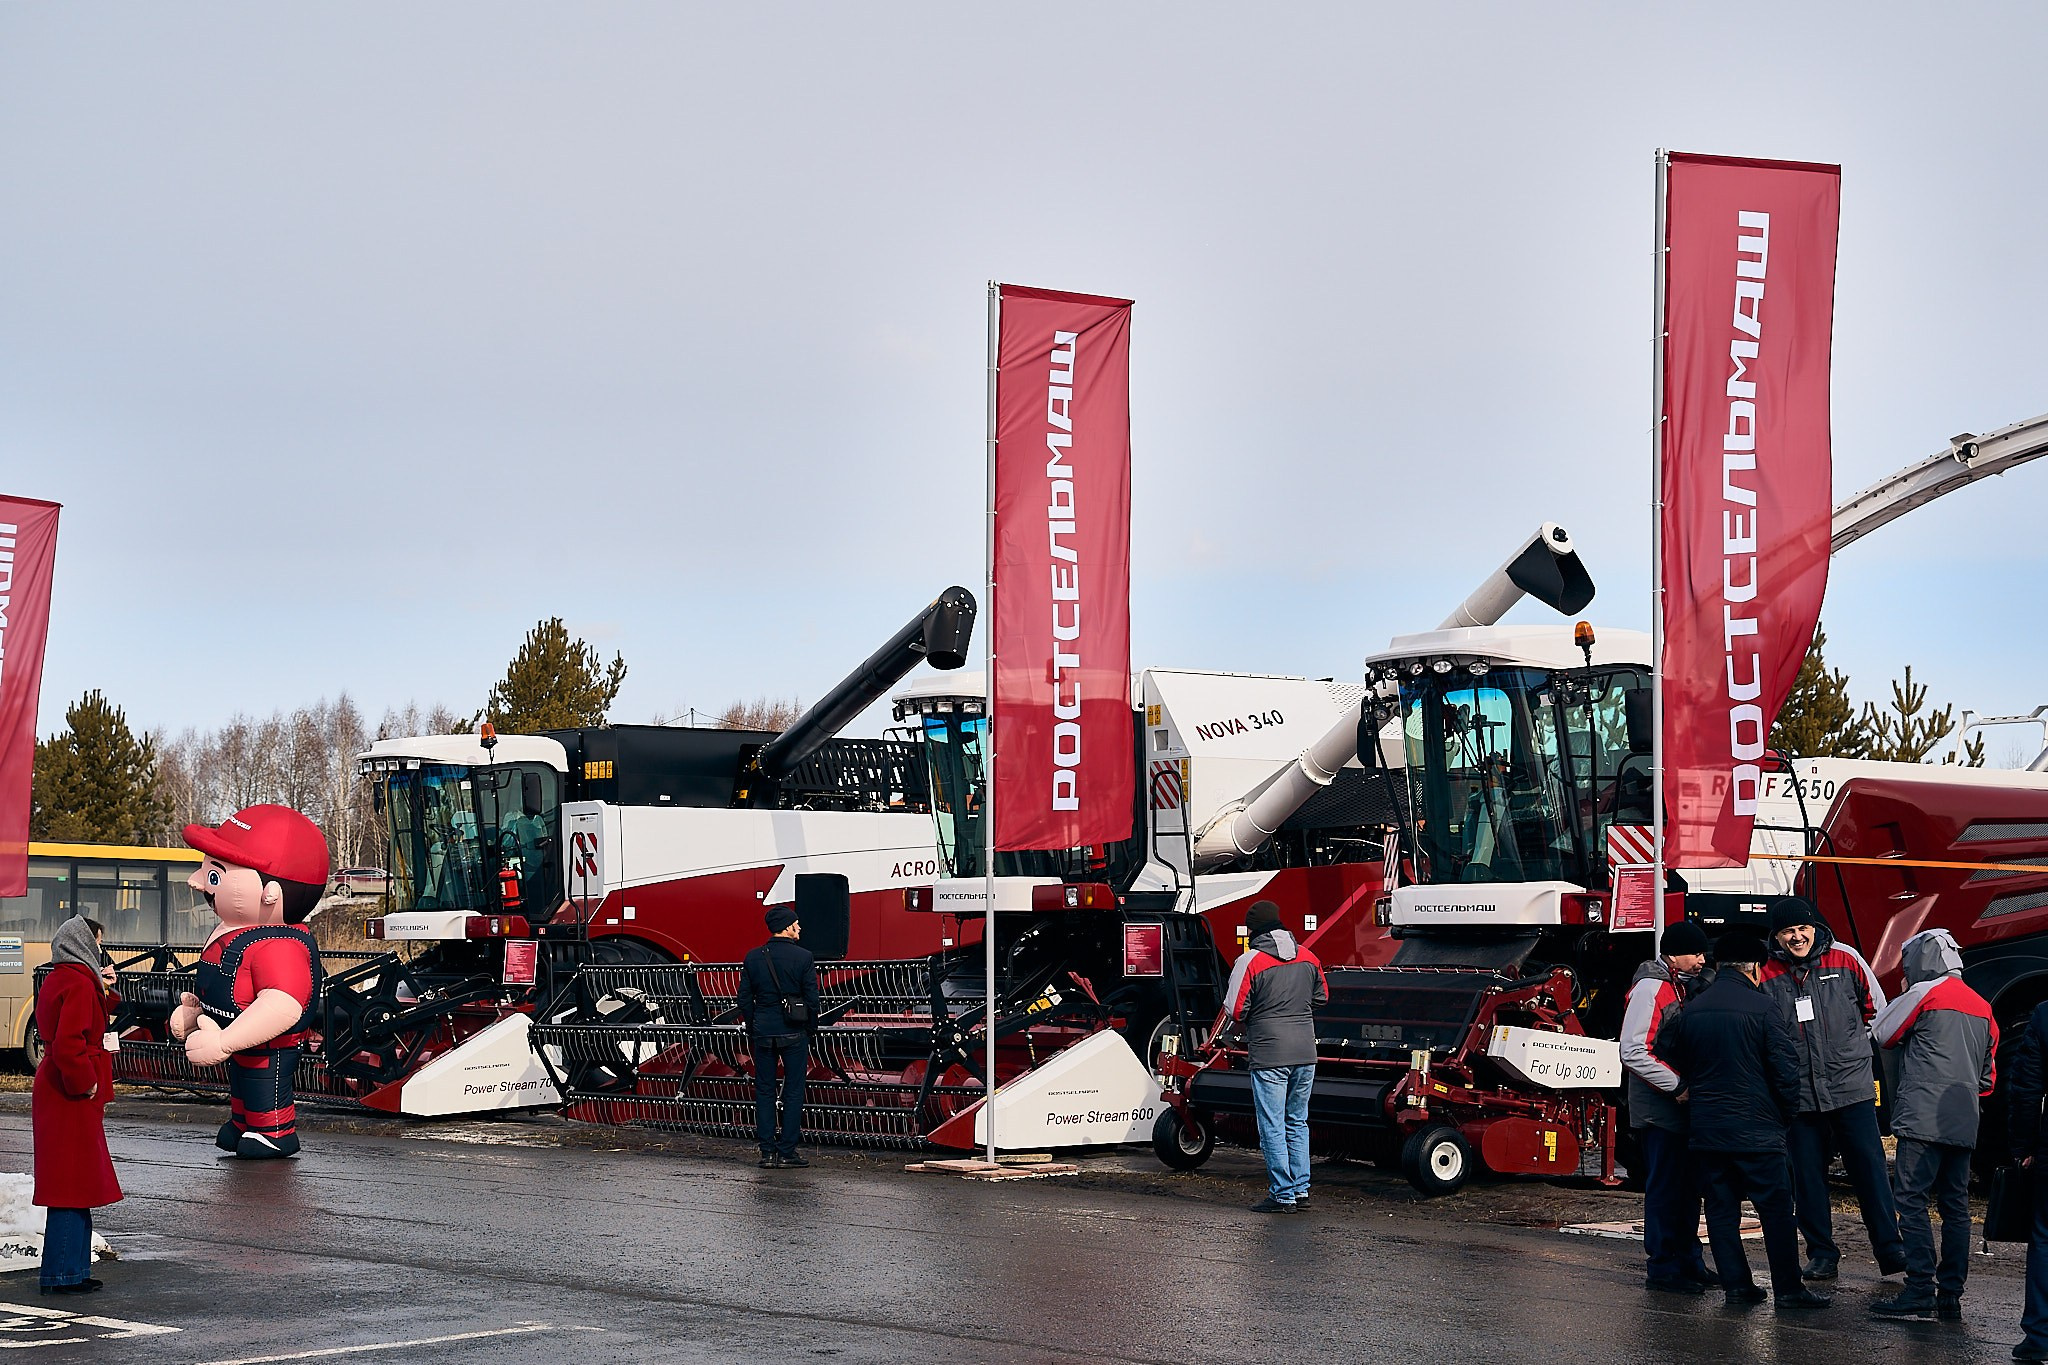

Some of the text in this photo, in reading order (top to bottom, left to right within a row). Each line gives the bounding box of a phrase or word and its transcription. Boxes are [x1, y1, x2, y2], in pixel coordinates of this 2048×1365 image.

[1722, 209, 1770, 816] РОСТСЕЛЬМАШ
[1046, 330, 1081, 811] РОСТСЕЛЬМАШ
[1195, 709, 1284, 741] NOVA 340
[1765, 777, 1835, 800] F 2650
[1414, 904, 1496, 912] РОСТСЕЛЬМАШ
[1530, 1059, 1597, 1080] For Up 300
[463, 1078, 552, 1096] Power Stream 70
[1046, 1107, 1154, 1126] Power Stream 600
